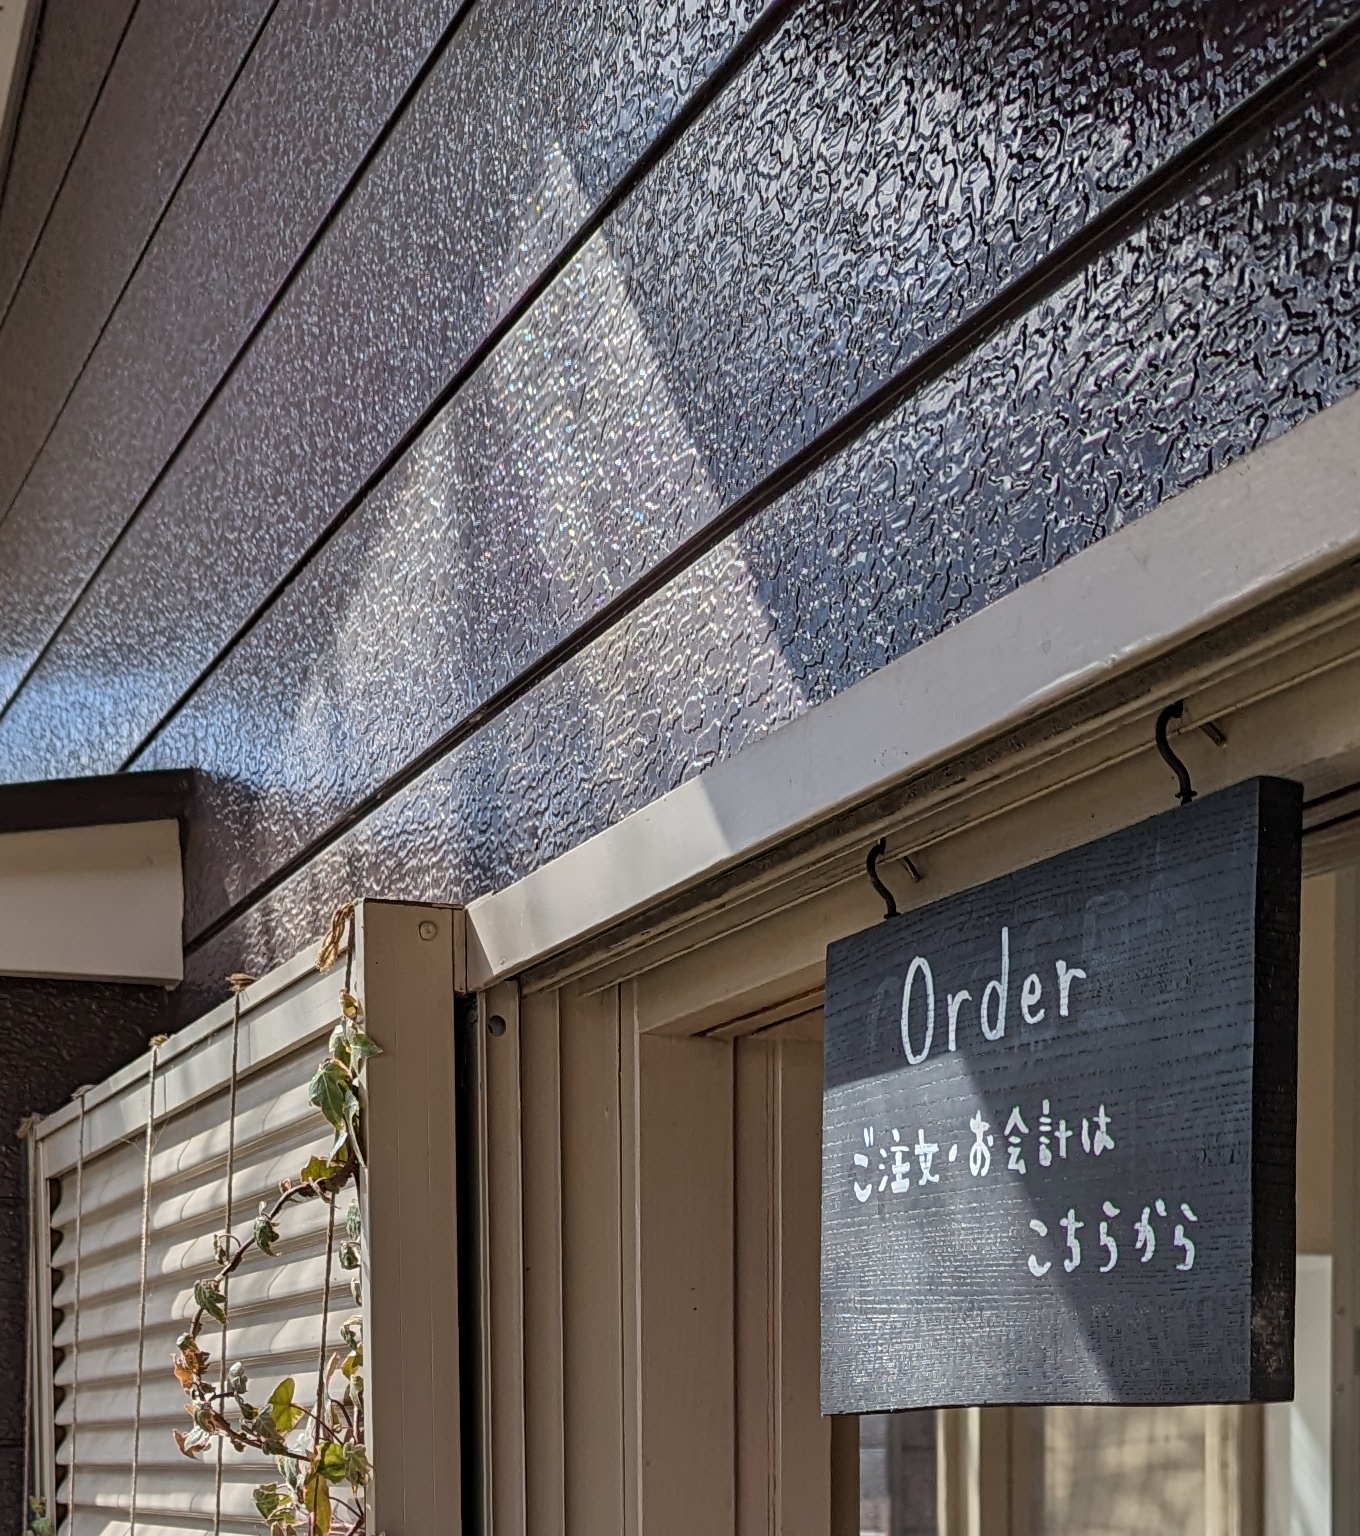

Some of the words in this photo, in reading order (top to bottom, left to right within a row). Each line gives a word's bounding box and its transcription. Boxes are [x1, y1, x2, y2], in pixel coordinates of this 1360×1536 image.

[901, 926, 1087, 1065] Order
[852, 1098, 1115, 1203] ご注文・お会計は
[1028, 1198, 1198, 1277] こちらから
